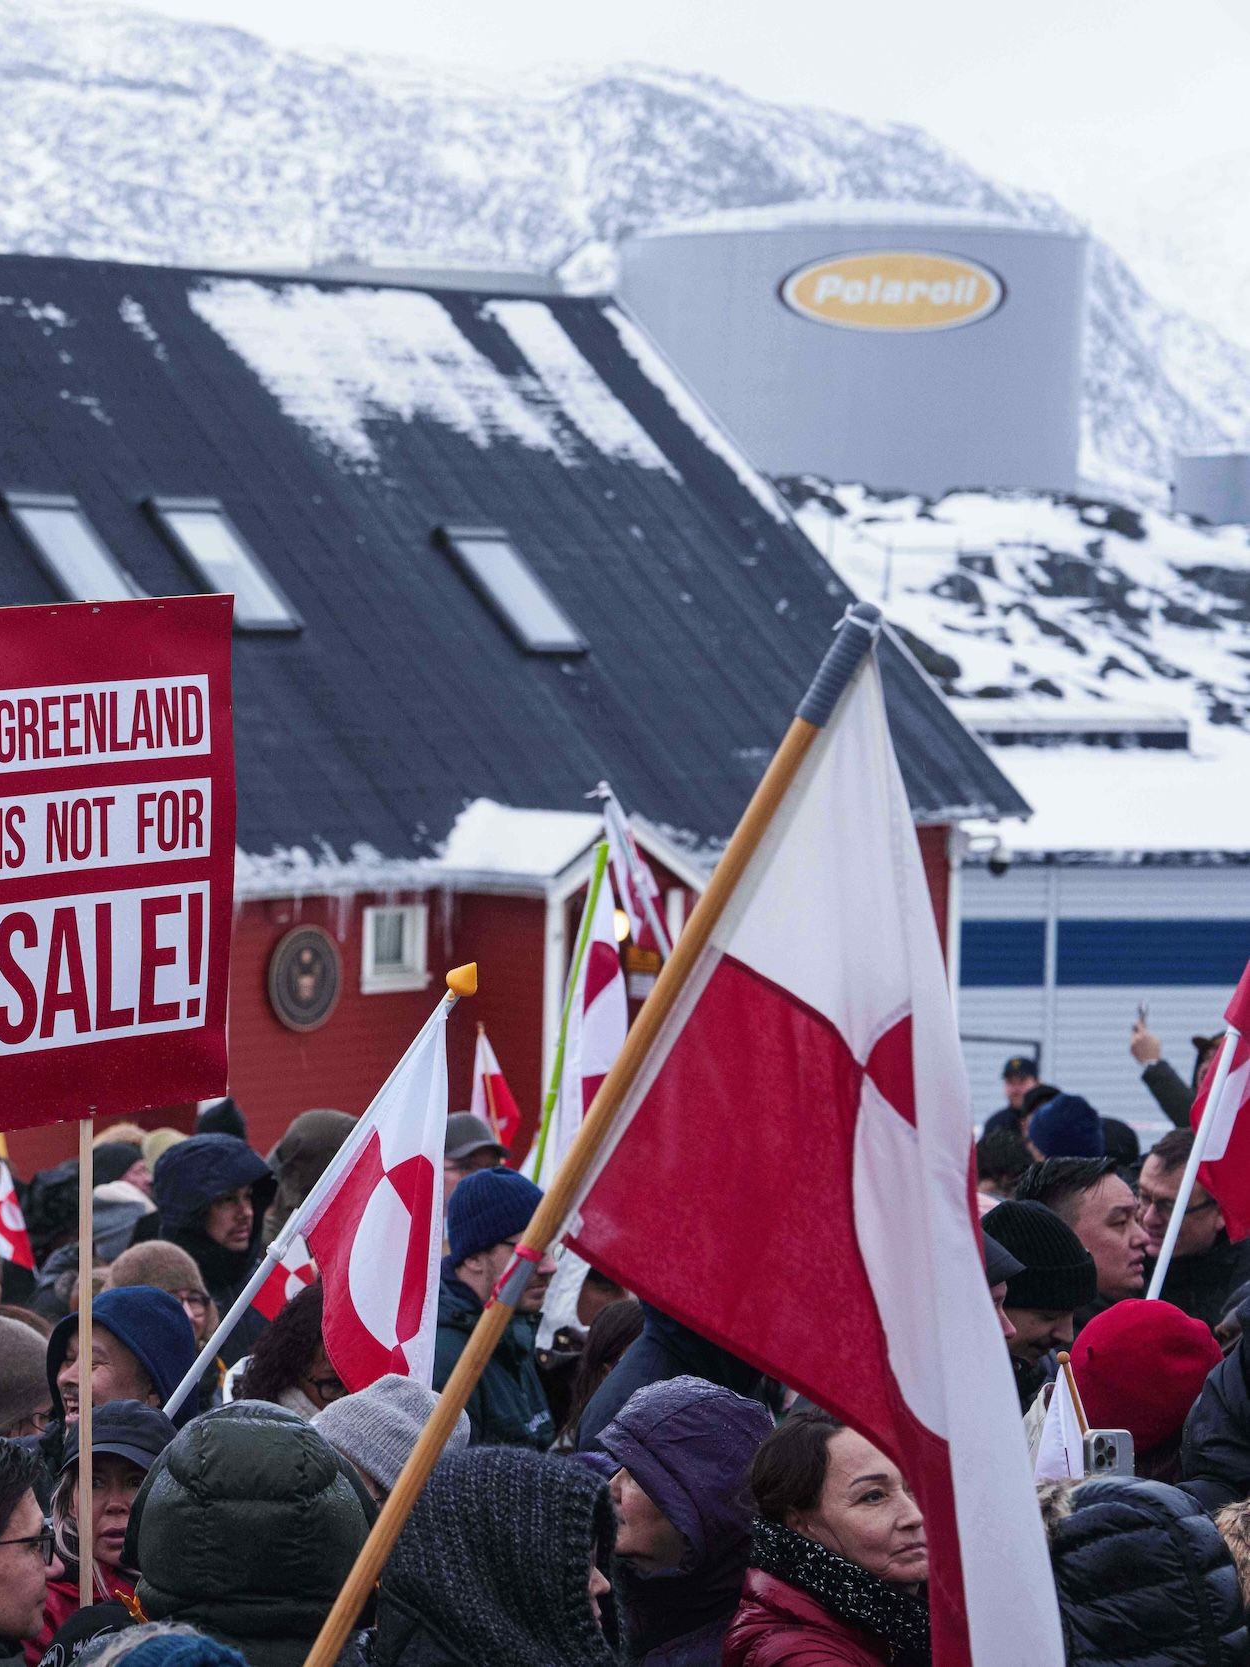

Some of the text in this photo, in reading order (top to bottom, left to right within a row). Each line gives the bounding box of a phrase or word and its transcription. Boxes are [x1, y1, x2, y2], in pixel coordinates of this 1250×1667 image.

[812, 272, 978, 305] Polaroil
[46, 795, 116, 864] NOT
[137, 788, 204, 854] FOR
